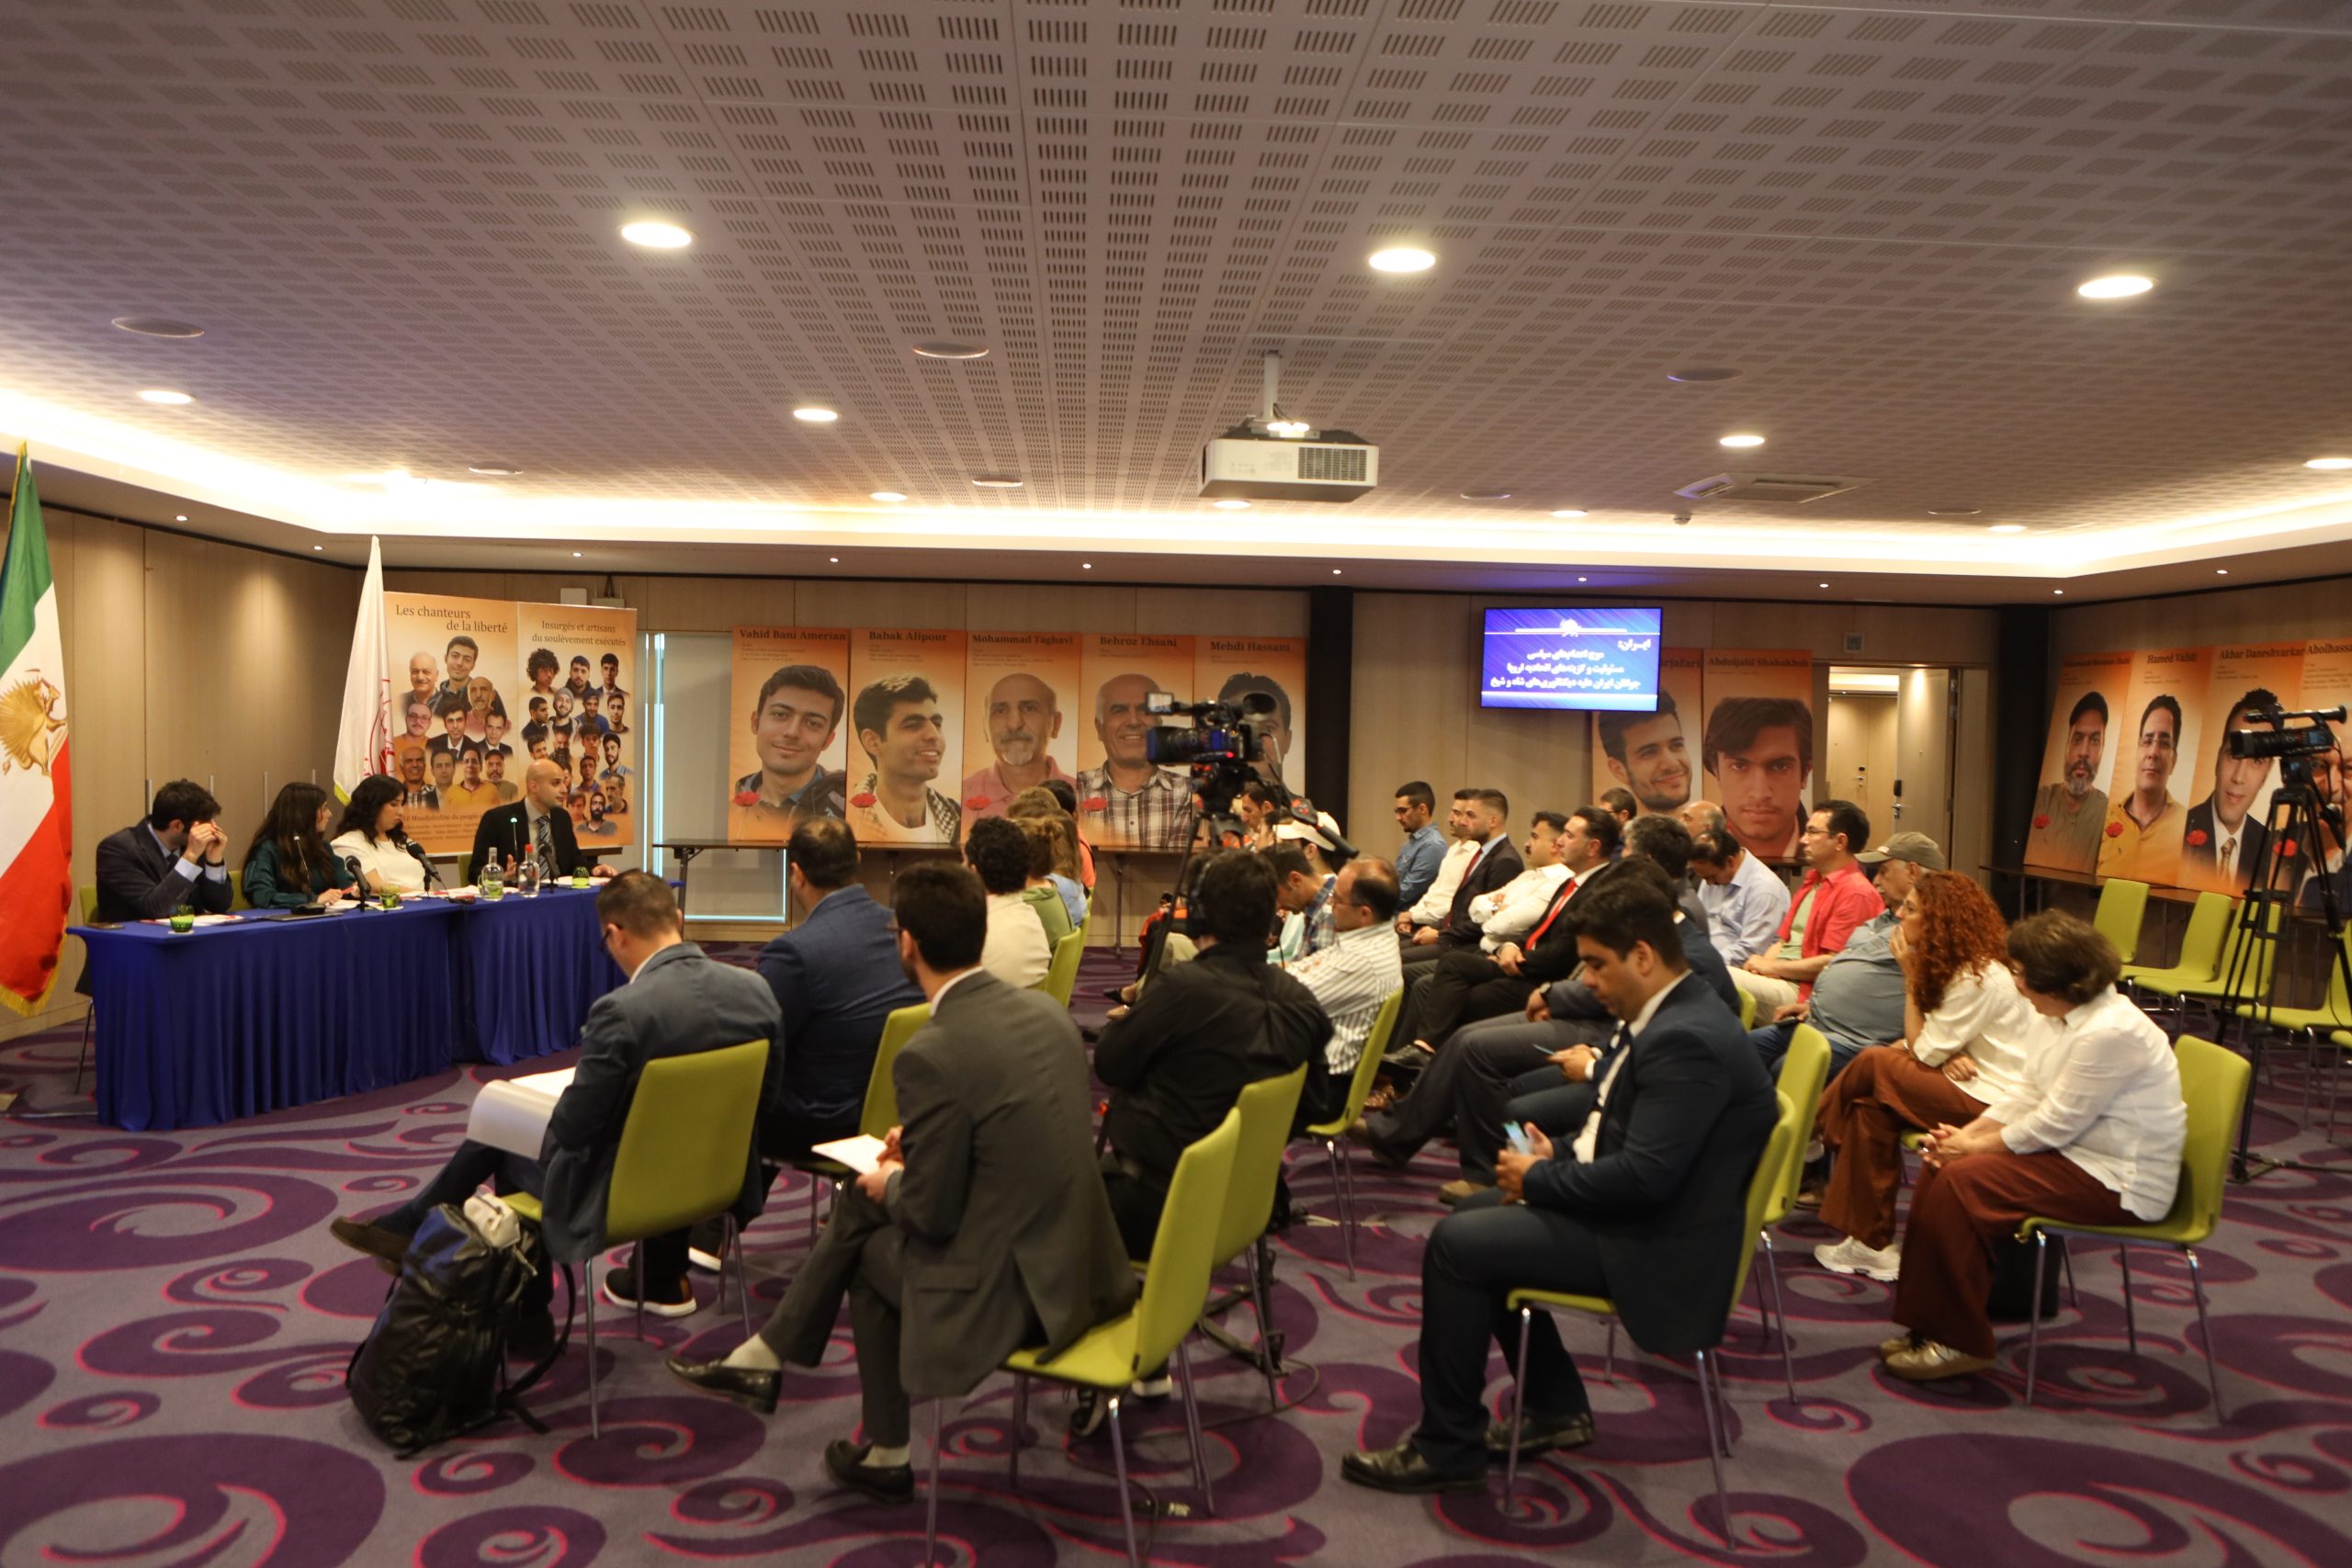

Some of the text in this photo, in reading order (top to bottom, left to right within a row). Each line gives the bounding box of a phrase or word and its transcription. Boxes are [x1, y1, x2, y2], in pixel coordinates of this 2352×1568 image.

[396, 604, 471, 619] Les chanteurs
[447, 619, 508, 634] de la liberté
[542, 620, 616, 634] Insurgés et artisans
[532, 633, 626, 647] du soulèvement exécutés
[740, 629, 846, 641] Vahid Bani Amerian
[868, 631, 947, 643] Babak Alipour
[972, 635, 1073, 645] Mohammad Taghavi
[1100, 637, 1177, 647] Behroz Ehsani
[1210, 640, 1290, 652] Mehdi Hassani
[2147, 653, 2173, 664] Hamed
